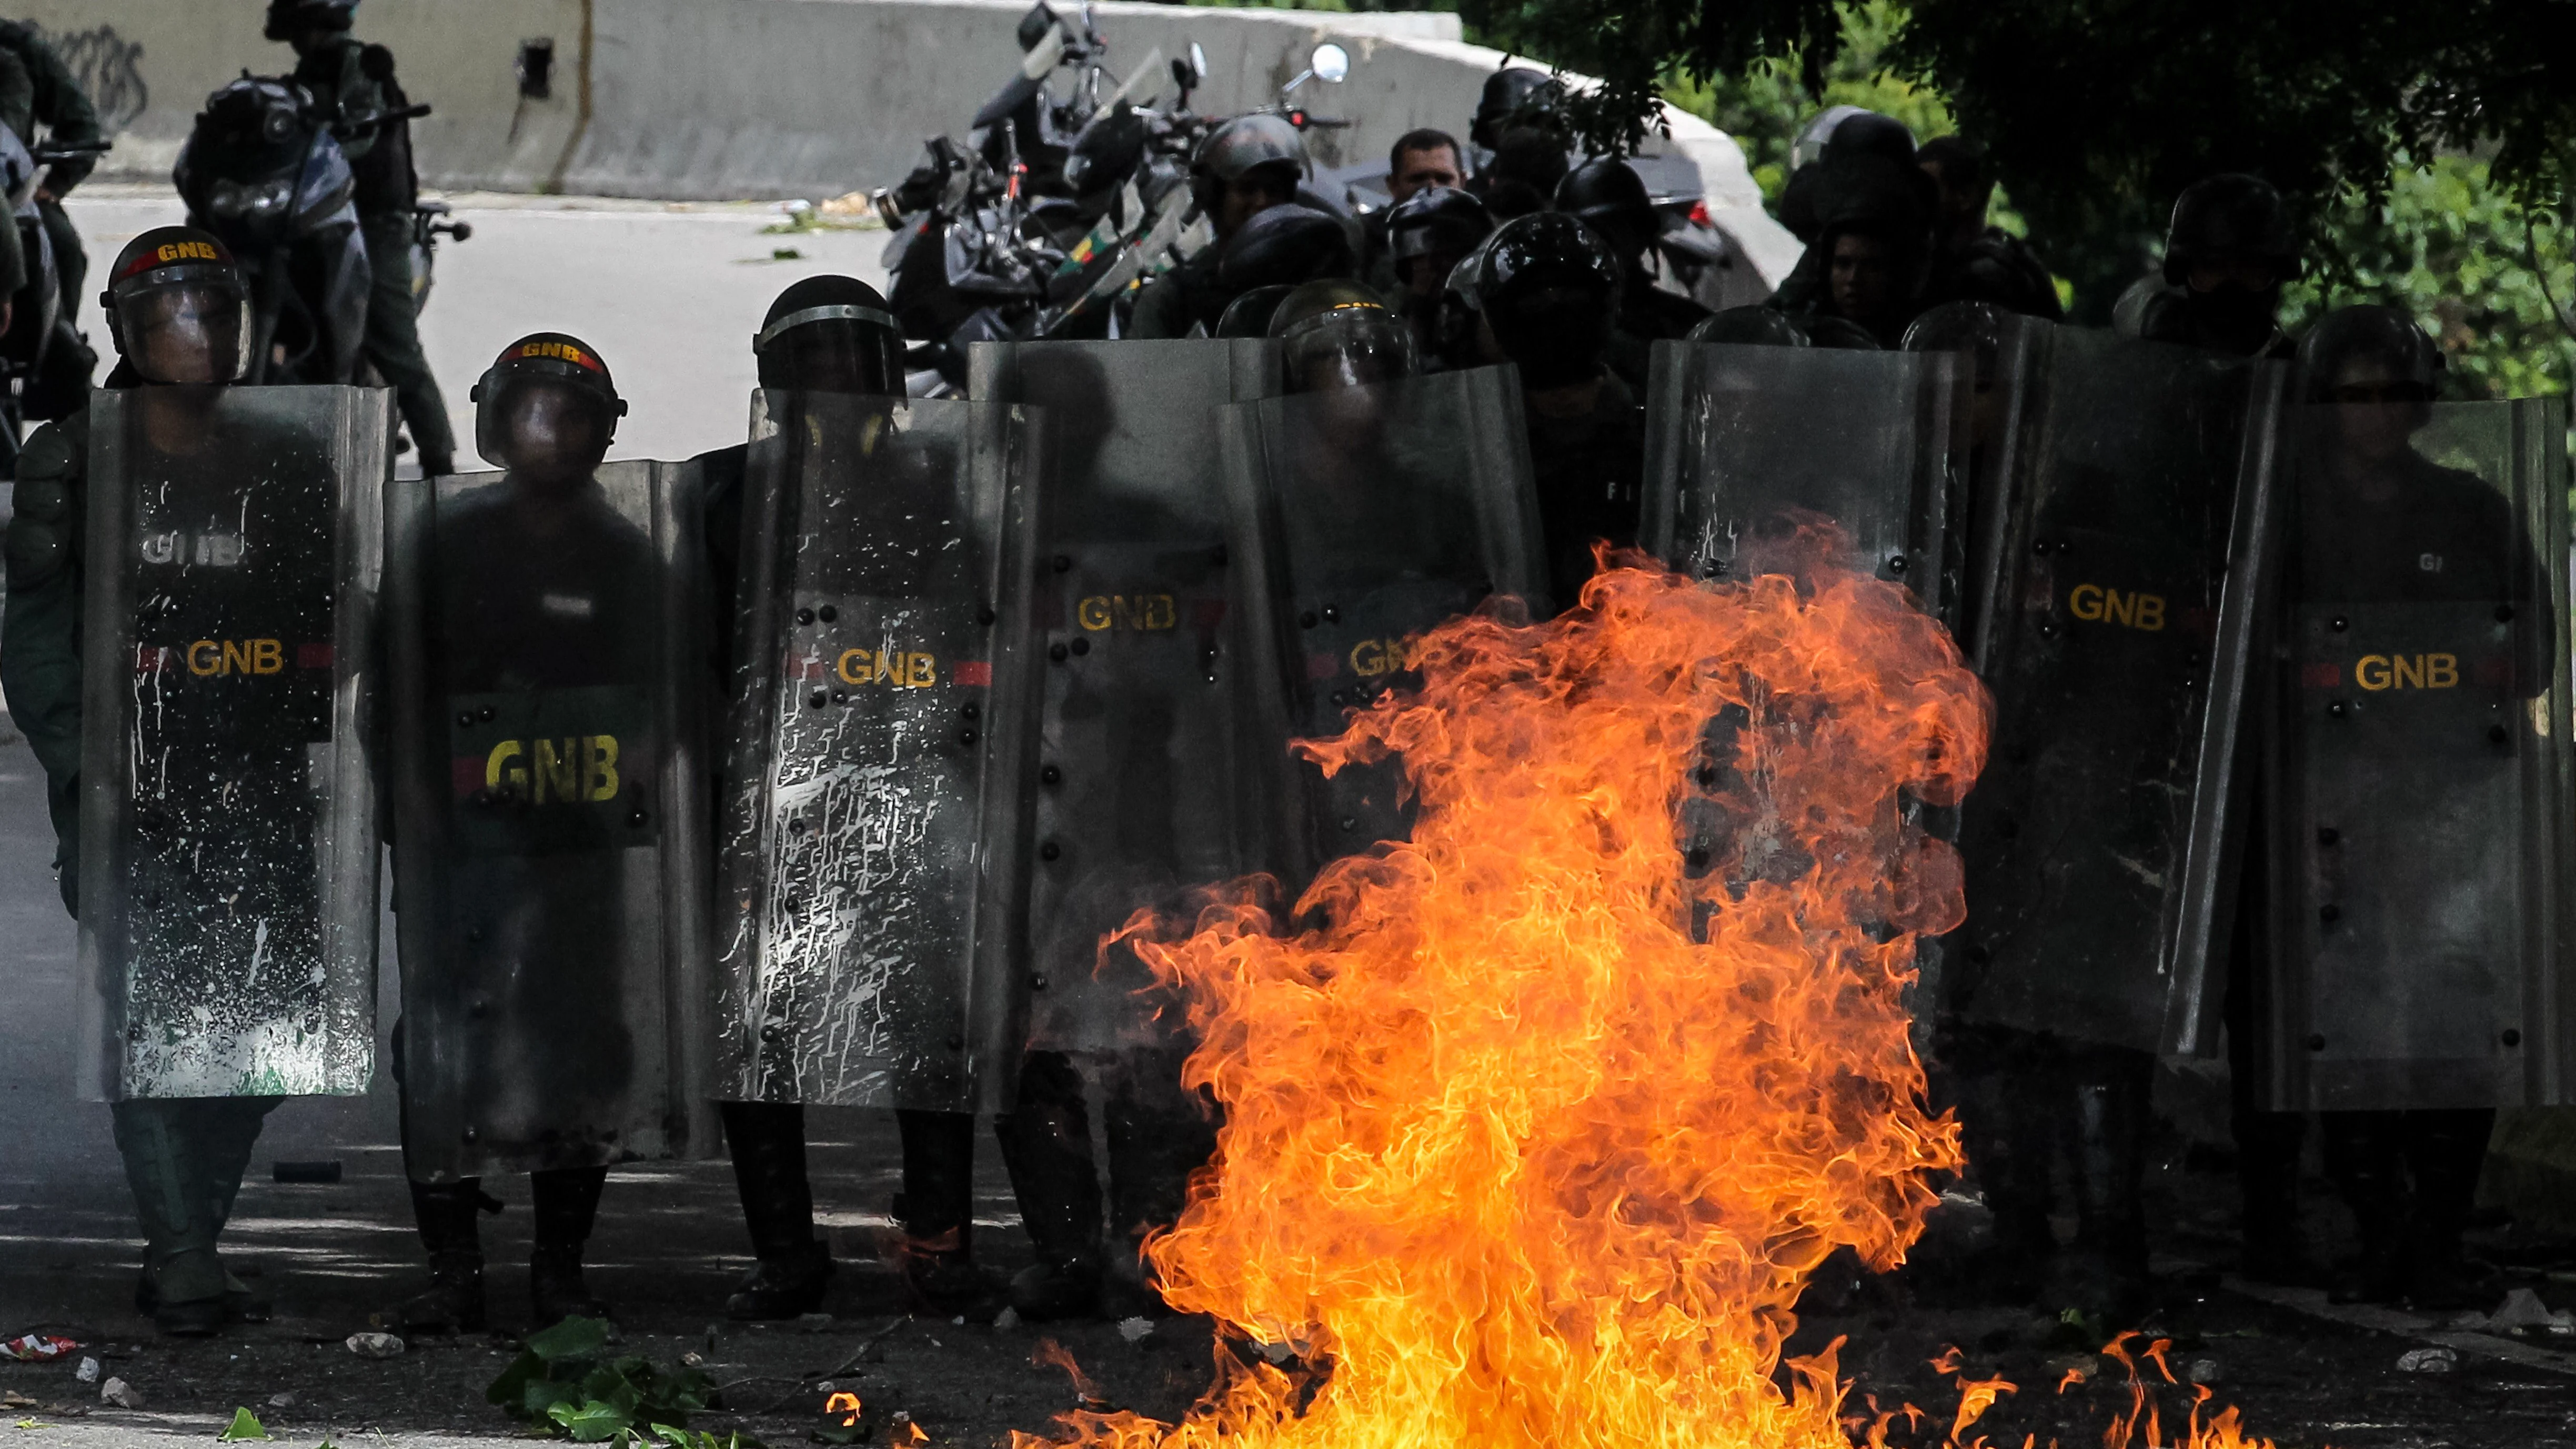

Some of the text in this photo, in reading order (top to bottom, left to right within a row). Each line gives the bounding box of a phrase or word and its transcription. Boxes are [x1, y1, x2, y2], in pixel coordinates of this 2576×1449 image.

[158, 242, 217, 262] GNB
[522, 342, 580, 363] GNB
[2069, 583, 2167, 631] GNB
[187, 638, 284, 676] GNB
[838, 648, 937, 688] GNB
[2355, 652, 2460, 691] GNB
[486, 734, 620, 805] GNB
